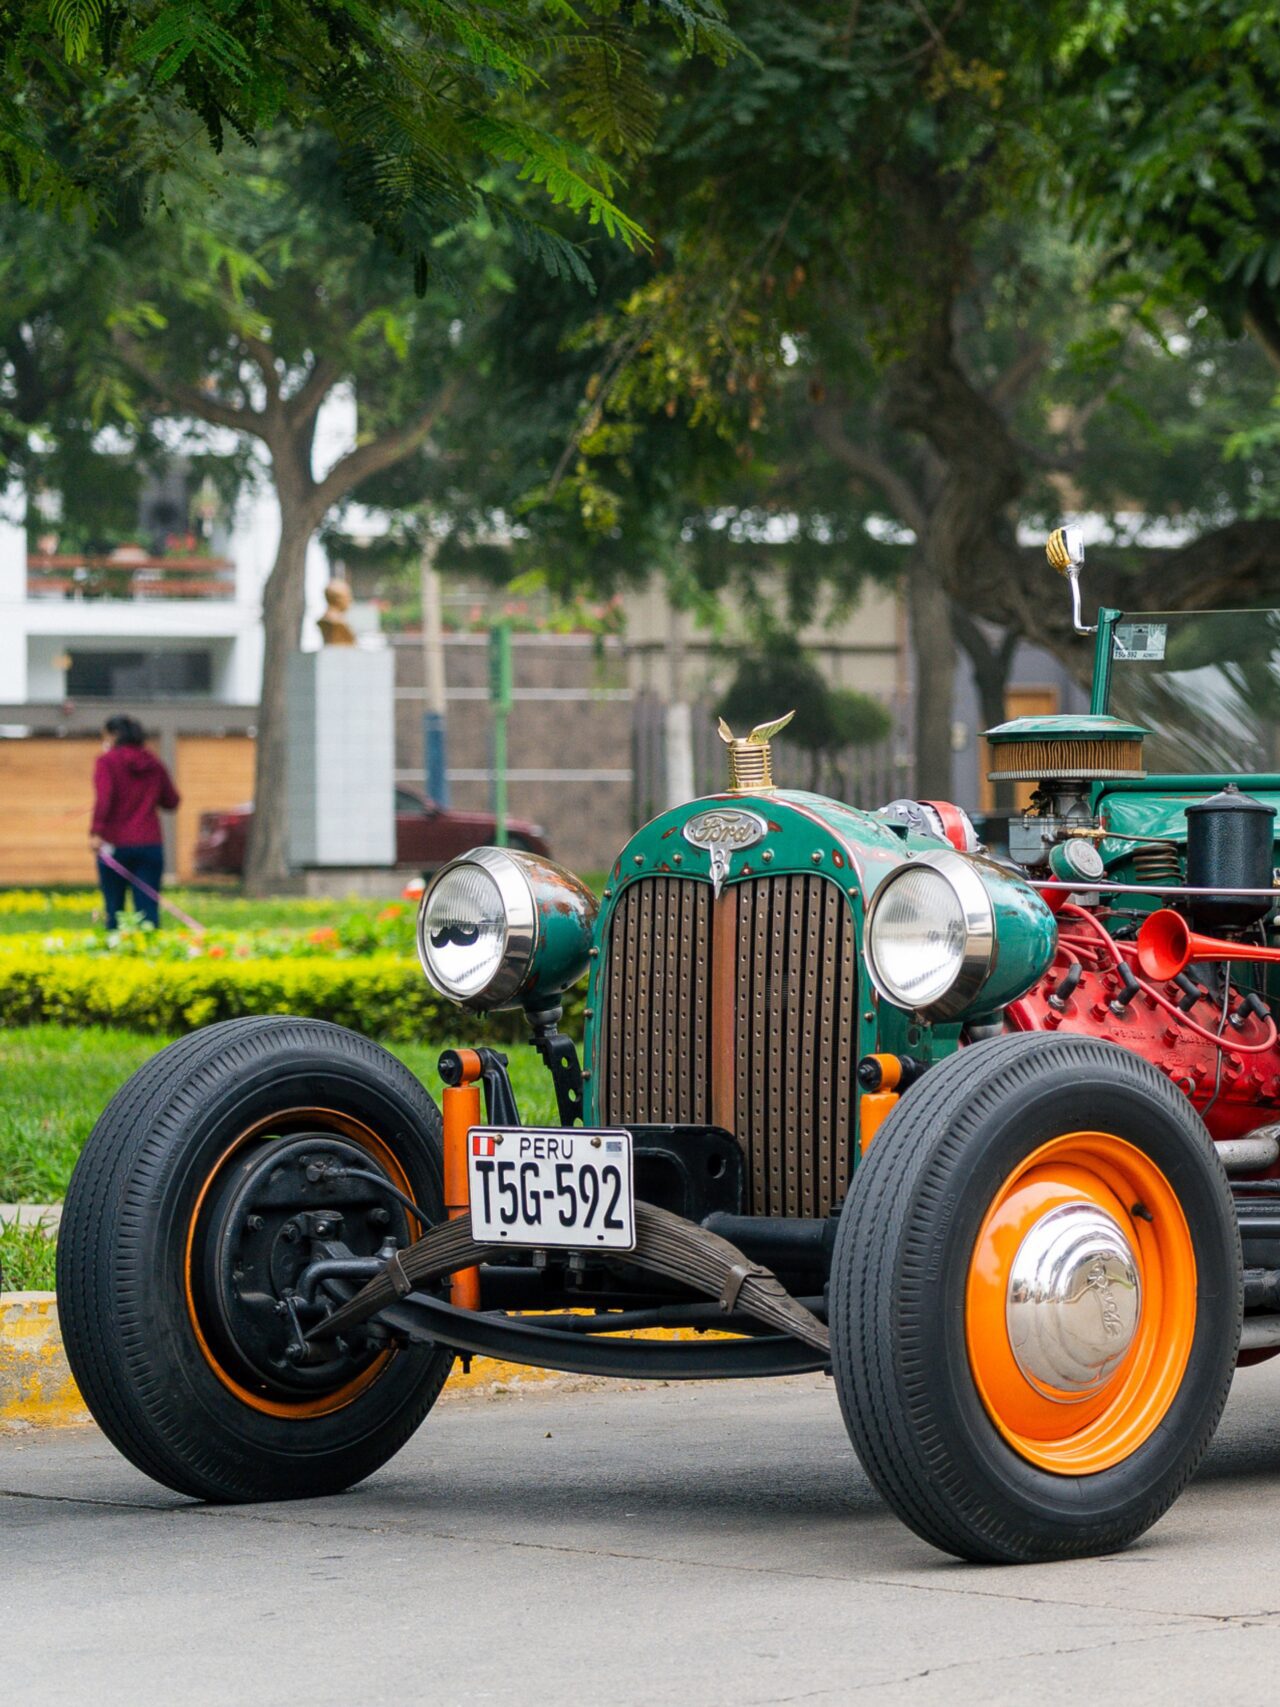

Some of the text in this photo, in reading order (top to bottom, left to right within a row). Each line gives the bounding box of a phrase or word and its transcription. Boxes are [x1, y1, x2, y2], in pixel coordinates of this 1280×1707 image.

[693, 814, 754, 842] Ford
[520, 1137, 574, 1159] PERU
[475, 1160, 624, 1229] T5G-592
